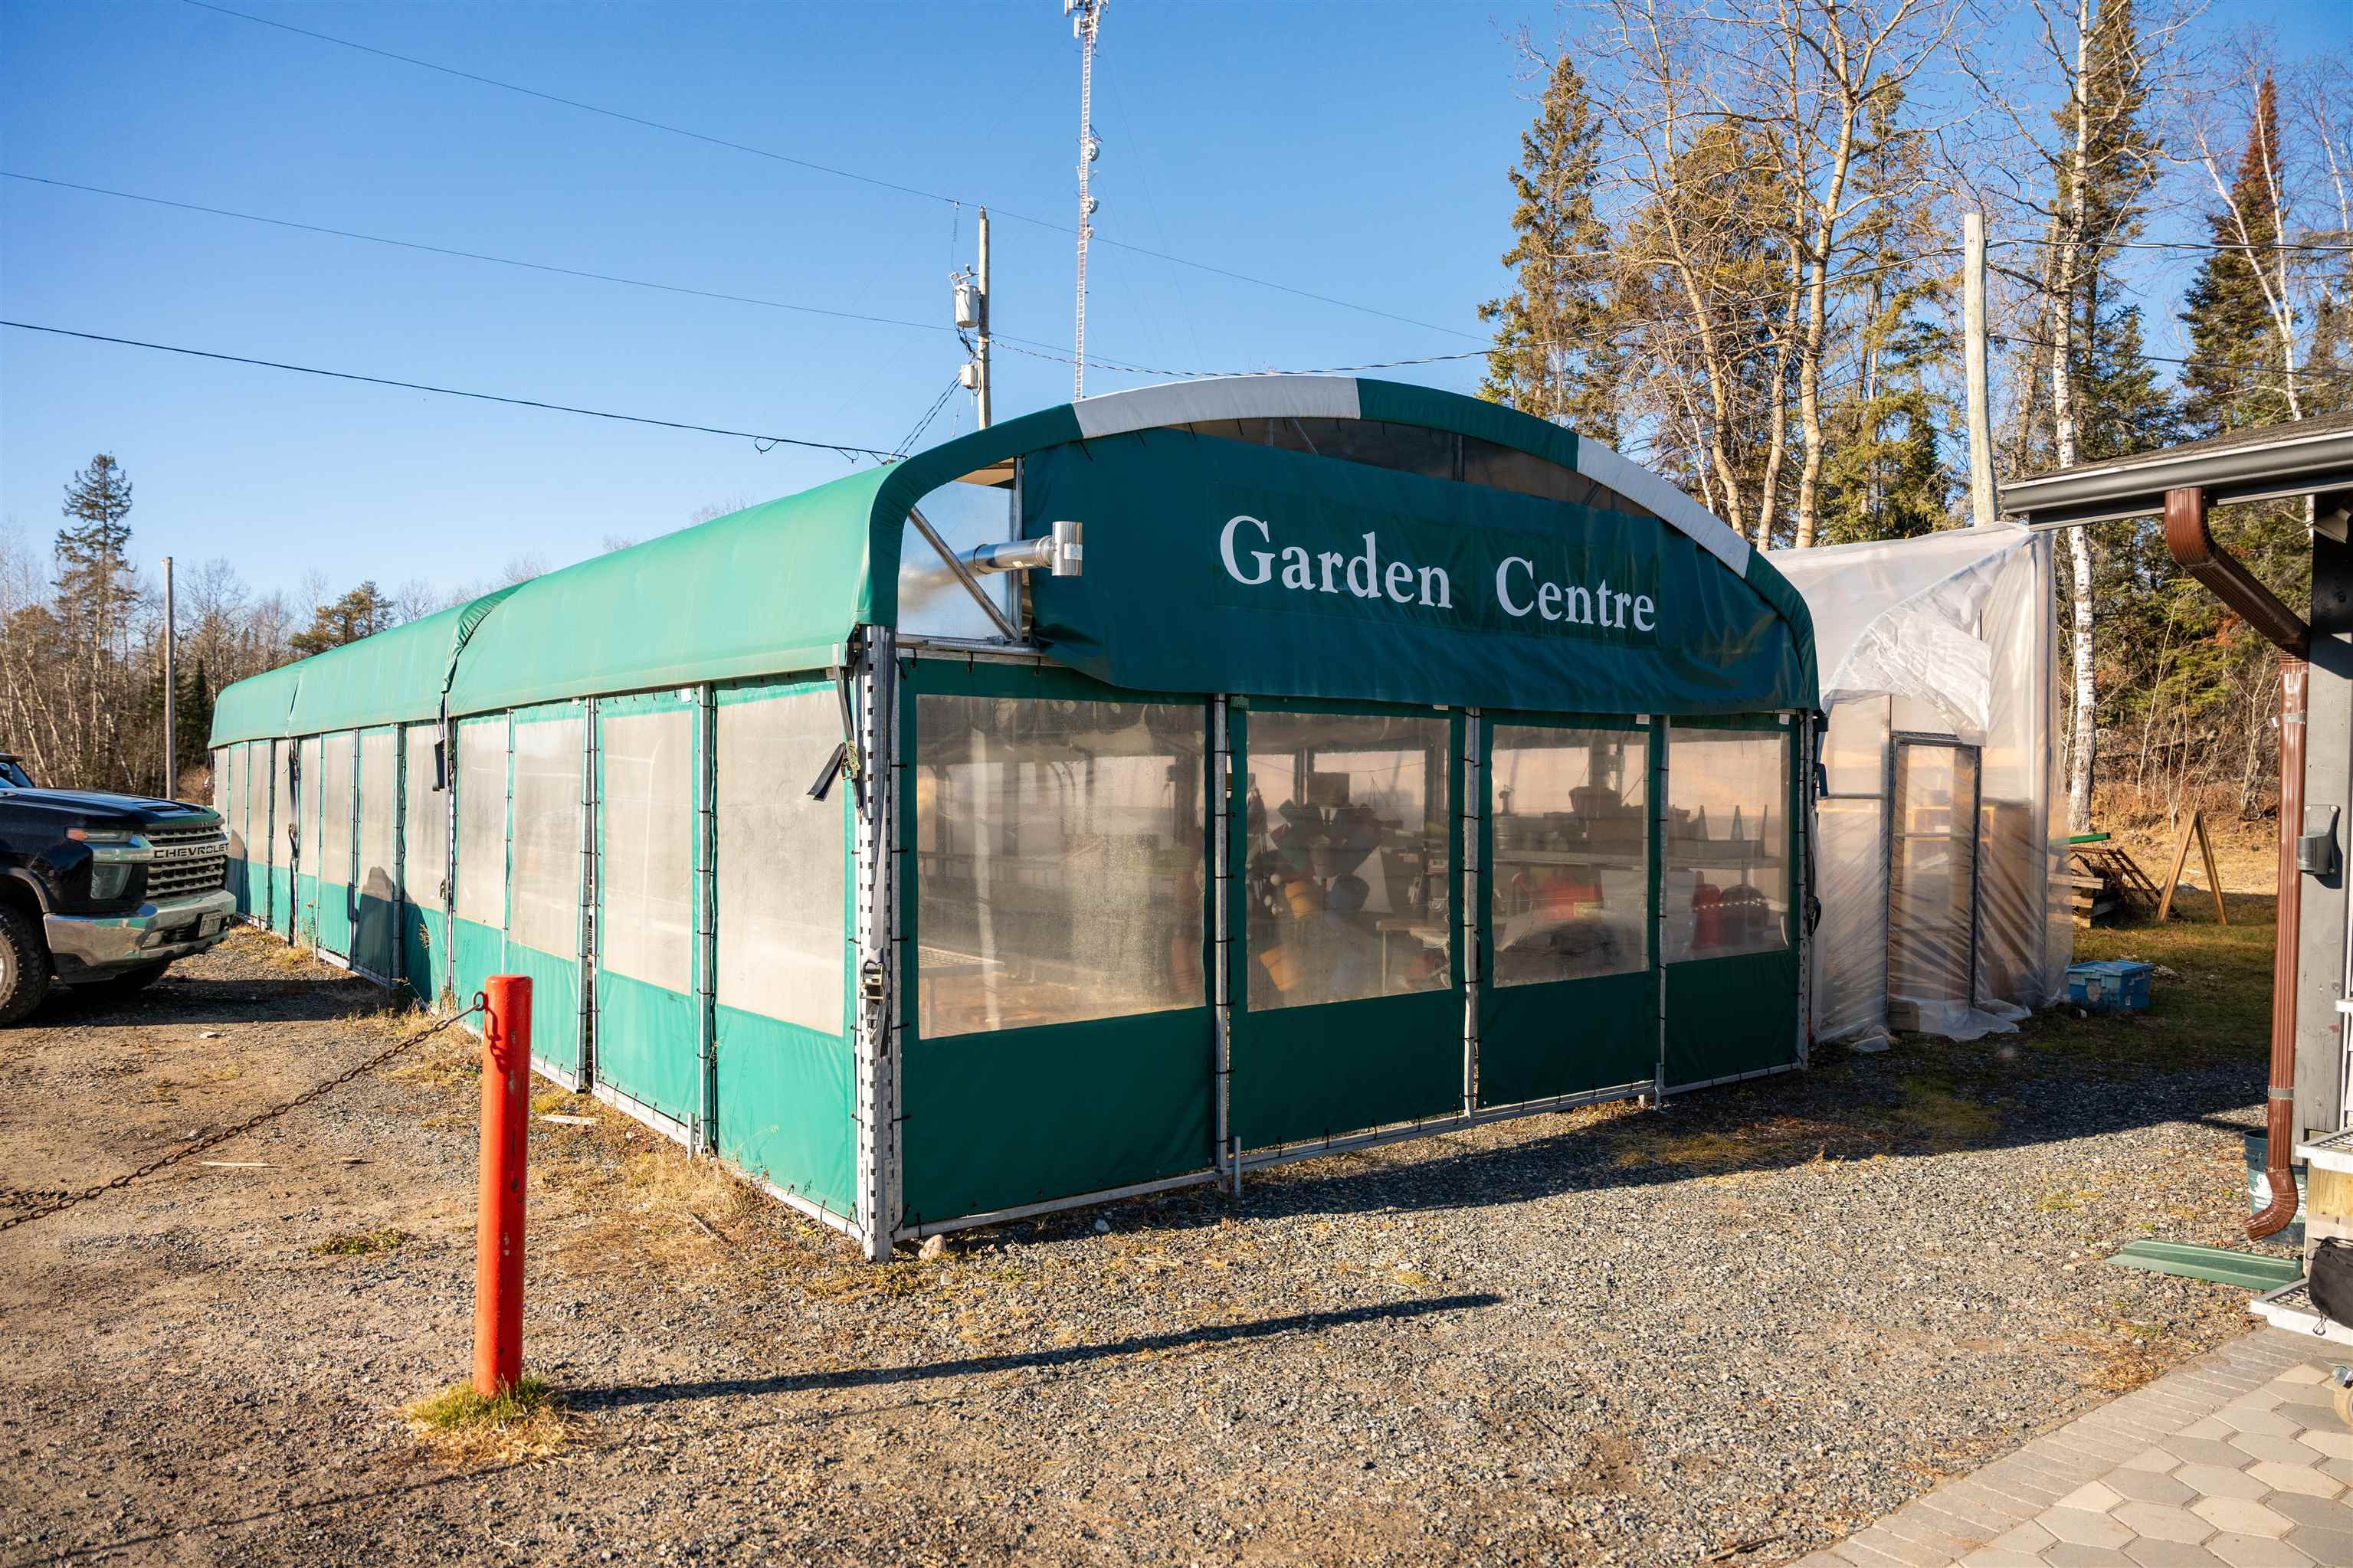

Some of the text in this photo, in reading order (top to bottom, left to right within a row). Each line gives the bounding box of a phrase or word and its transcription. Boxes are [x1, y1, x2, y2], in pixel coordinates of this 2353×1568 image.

[1220, 515, 1655, 631] Garden Centre
[154, 843, 229, 858] CHEVROLET
